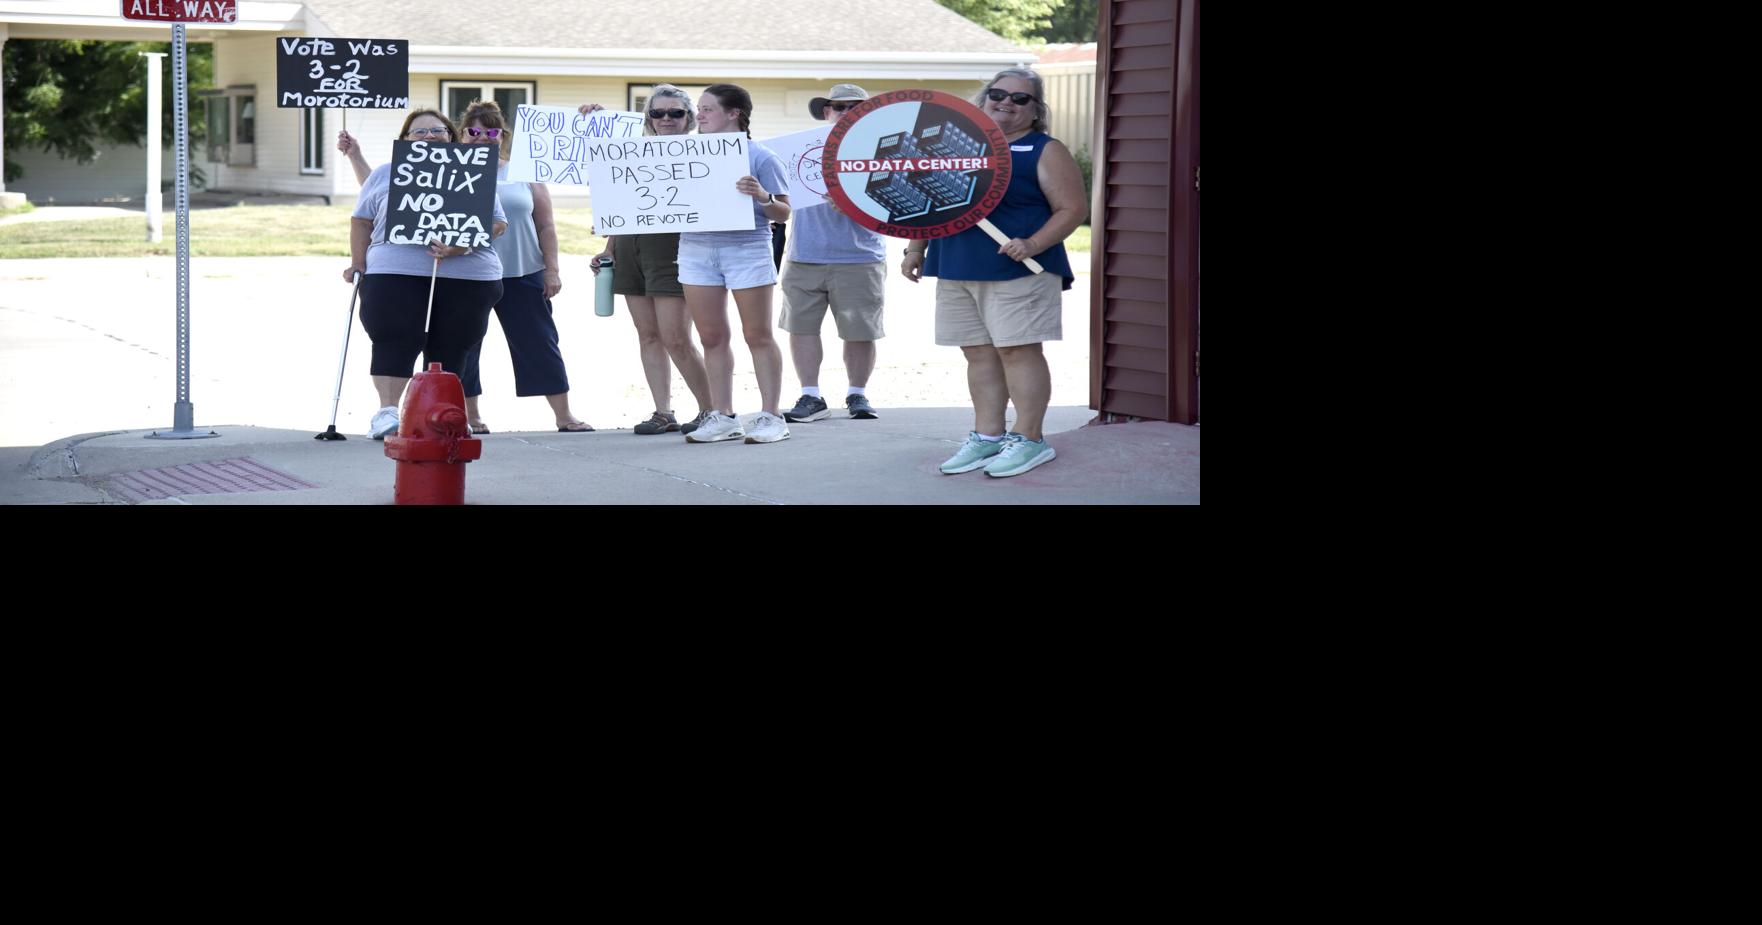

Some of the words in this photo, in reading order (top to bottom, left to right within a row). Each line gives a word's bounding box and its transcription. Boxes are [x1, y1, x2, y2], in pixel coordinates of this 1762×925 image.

[130, 0, 169, 17] ALL
[183, 0, 227, 18] WAY
[281, 38, 336, 55] Vote
[347, 40, 398, 56] Was
[319, 77, 365, 91] FOR
[517, 106, 565, 134] YOU
[571, 113, 643, 138] CAN'T
[825, 143, 839, 188] FARMS
[854, 98, 882, 116] FOR
[886, 90, 933, 102] FOOD
[589, 138, 742, 162] MORATORIUM
[611, 161, 710, 184] PASSED
[840, 160, 866, 172] NO
[868, 159, 915, 172] DATA
[917, 157, 988, 170] CENTER!
[876, 222, 951, 239] PROTECT
[953, 208, 984, 230] OUR
[982, 128, 1010, 210] COMMUNITY
[397, 192, 444, 212] NO
[417, 212, 485, 232] DATA
[600, 215, 626, 229] NO
